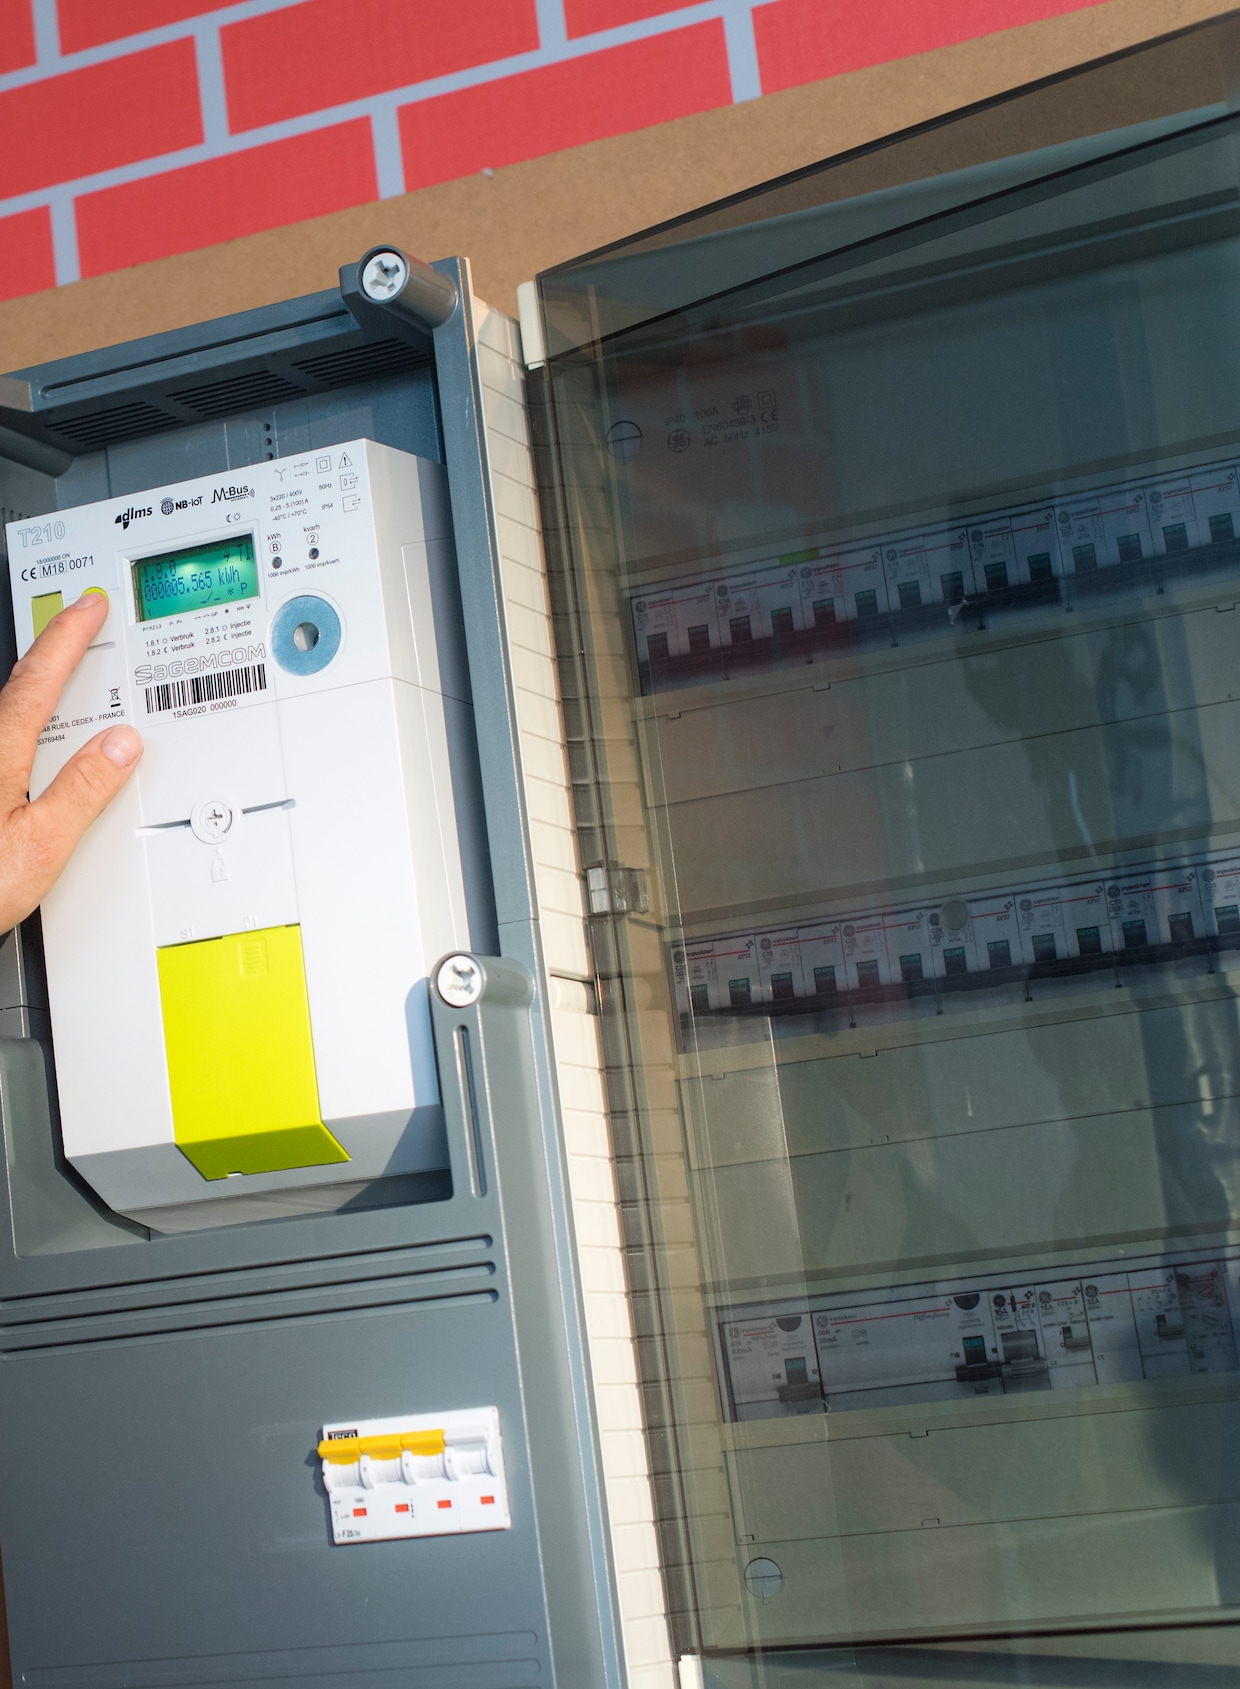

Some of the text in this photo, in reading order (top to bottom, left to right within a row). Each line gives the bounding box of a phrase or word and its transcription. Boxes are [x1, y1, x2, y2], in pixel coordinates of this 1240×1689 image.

[664, 407, 720, 426] IP40 100A
[704, 436, 719, 448] AC
[211, 485, 249, 504] M-Bus
[17, 520, 66, 548] T210
[267, 532, 281, 541] kWh
[41, 562, 65, 577] M18
[69, 555, 94, 570] 0071
[143, 560, 177, 583] 1.8.0
[144, 565, 240, 602] 000005.565 kWh
[205, 620, 251, 635] 2.8.1 Injectie
[146, 631, 194, 647] 1.8.1 Verbruik
[206, 630, 252, 645] 2.8.2 Injectie
[147, 641, 195, 657] 1.8.2 Verbruik
[173, 699, 237, 719] 1SAG020 000000
[52, 721, 70, 731] RUEIL
[72, 717, 93, 726] CEDEX
[98, 710, 125, 721] FRANCE
